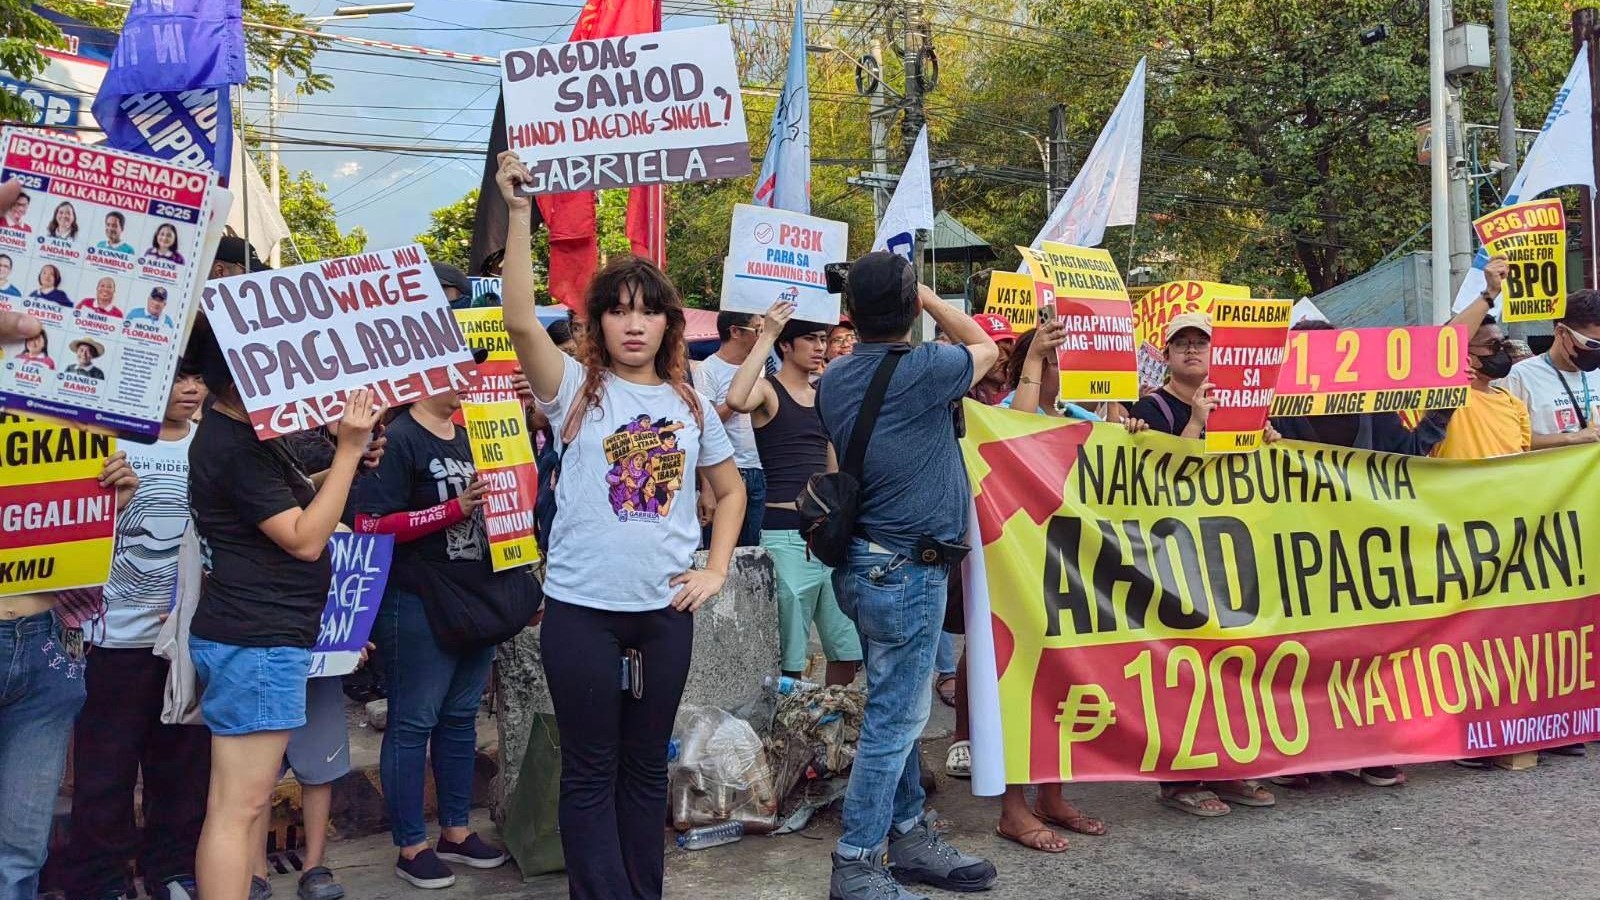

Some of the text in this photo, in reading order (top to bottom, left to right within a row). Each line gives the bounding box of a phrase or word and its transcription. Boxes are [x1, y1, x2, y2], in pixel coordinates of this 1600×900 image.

[505, 36, 659, 83] DAGDAG-
[508, 119, 566, 149] HINDI
[10, 137, 205, 193] IBOTO SA SENADO
[30, 160, 176, 200] TAUMBAYAN IPANALO!
[52, 181, 147, 212] MAKABAYAN
[0, 236, 27, 248] DONIS
[51, 239, 73, 249] ALYN
[779, 223, 824, 252] P33K
[1494, 232, 1560, 251] ENTRY-LEVEL
[40, 243, 80, 259] ANDAMO
[766, 248, 810, 268] PARA SA
[1505, 246, 1554, 262] WAGE FOR
[86, 254, 134, 271] ARAMBULO
[142, 265, 178, 279] BROSAS
[320, 252, 392, 281] NATIONAL
[392, 246, 428, 268] MIN.
[1049, 253, 1116, 275] IPAGTANGGOL!
[747, 261, 803, 281] KAWANING
[805, 271, 818, 285] SG
[1055, 271, 1124, 292] IPAGLABAN!
[1507, 261, 1558, 300] BPO
[329, 268, 429, 314] WAGE
[778, 291, 799, 302] ACT
[997, 288, 1017, 305] VAT
[1020, 290, 1032, 306] SA
[27, 308, 64, 321] CASTRO
[1132, 281, 1204, 329] SAHOD
[1216, 304, 1290, 323] IPAGLABAN!
[74, 318, 116, 332] DORINGO
[986, 317, 1008, 331] LA
[122, 327, 170, 343] FLORANDA
[1060, 334, 1134, 352] MAG-UNYON!
[227, 304, 468, 399] IPAGLABAN!
[1212, 347, 1284, 366] KATIYAKAN
[15, 371, 43, 384] MAZA
[21, 365, 41, 375] LIZA
[66, 374, 99, 386] DANILO
[1243, 368, 1261, 387] SA
[63, 381, 98, 395] RAMOS
[1090, 381, 1111, 394] KMU
[1271, 386, 1468, 416] IVING WAGE BUONG BANSA
[0, 427, 109, 467] GKAIN
[1235, 433, 1256, 447] KMU
[481, 442, 504, 463] ANG
[1077, 444, 1416, 507] NAKABUBUHAY NA
[488, 490, 519, 514] DAILY
[0, 495, 111, 532] GGALIN!
[409, 510, 447, 527] ITAAS!
[486, 510, 534, 537] MINIMUM
[503, 545, 522, 561] KMU
[0, 556, 55, 584] KMU
[1274, 510, 1586, 619] IPAGLABAN!
[1124, 640, 1310, 773] 1200
[1327, 624, 1596, 730] NATIONWIDE
[1467, 721, 1497, 750] ALL
[1501, 712, 1570, 747] WORKERS
